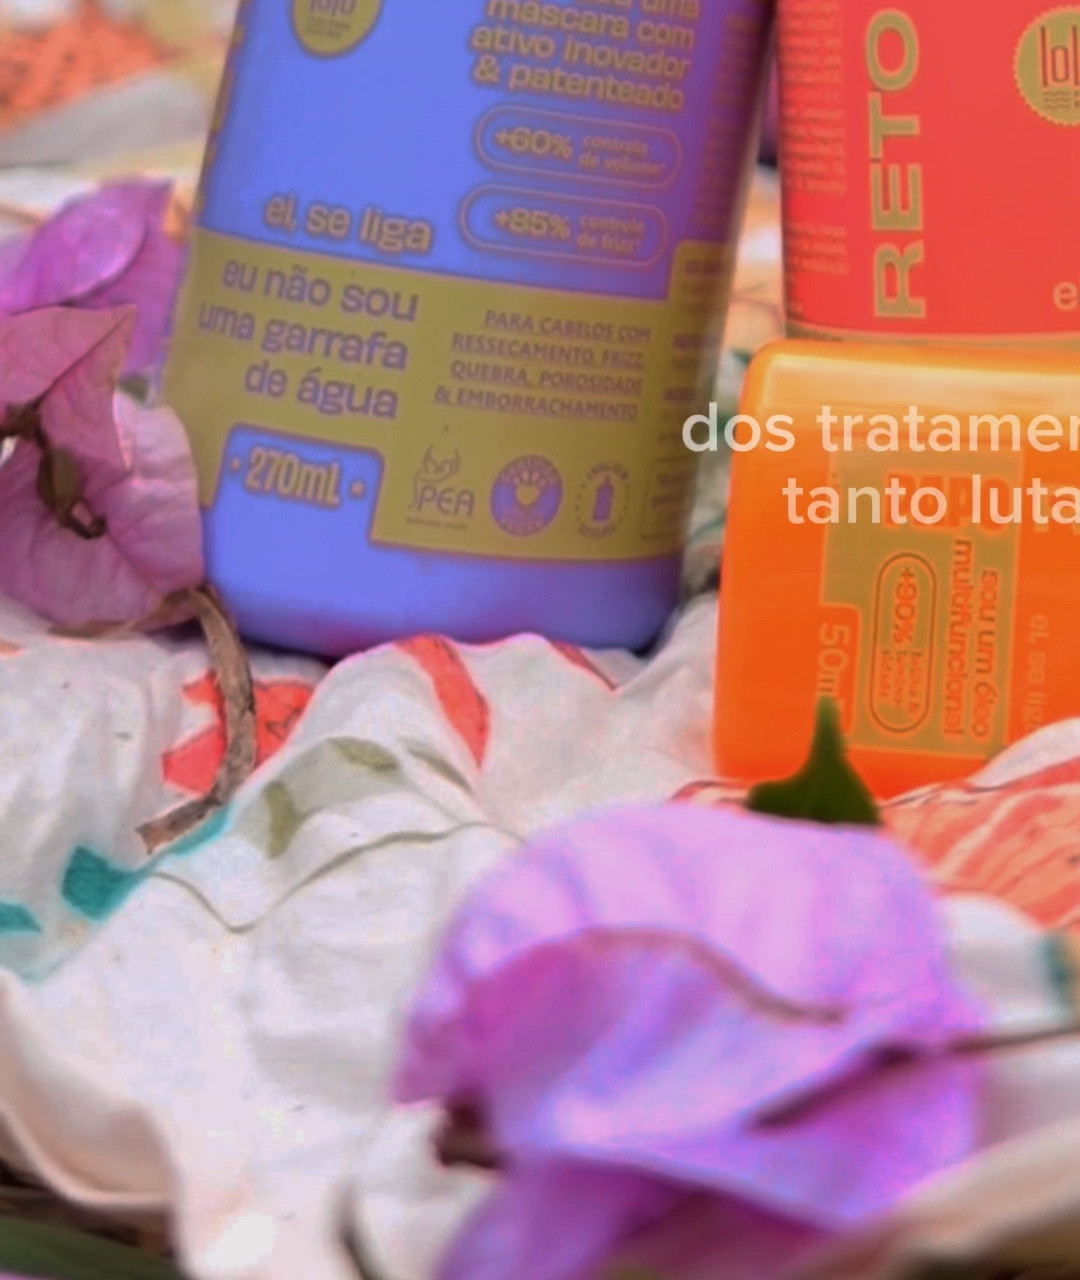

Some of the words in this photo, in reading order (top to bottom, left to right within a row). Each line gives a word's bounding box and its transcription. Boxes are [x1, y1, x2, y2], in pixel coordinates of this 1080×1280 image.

[471, 25, 556, 59] ativo
[564, 37, 693, 80] inovador
[636, 18, 696, 49] com
[473, 54, 500, 85] &
[509, 64, 685, 111] patenteado
[864, 6, 927, 321] RETO
[306, 203, 350, 238] se
[360, 207, 433, 254] liga
[222, 259, 258, 294] eu
[264, 264, 332, 307] não
[341, 283, 419, 323] sou
[199, 303, 256, 341] uma
[261, 318, 409, 371] garrafa
[485, 309, 533, 331] PARA
[244, 361, 288, 397] de
[297, 366, 398, 419] água
[978, 568, 998, 623] sou
[944, 538, 973, 737] multifuncional
[975, 628, 995, 676] um
